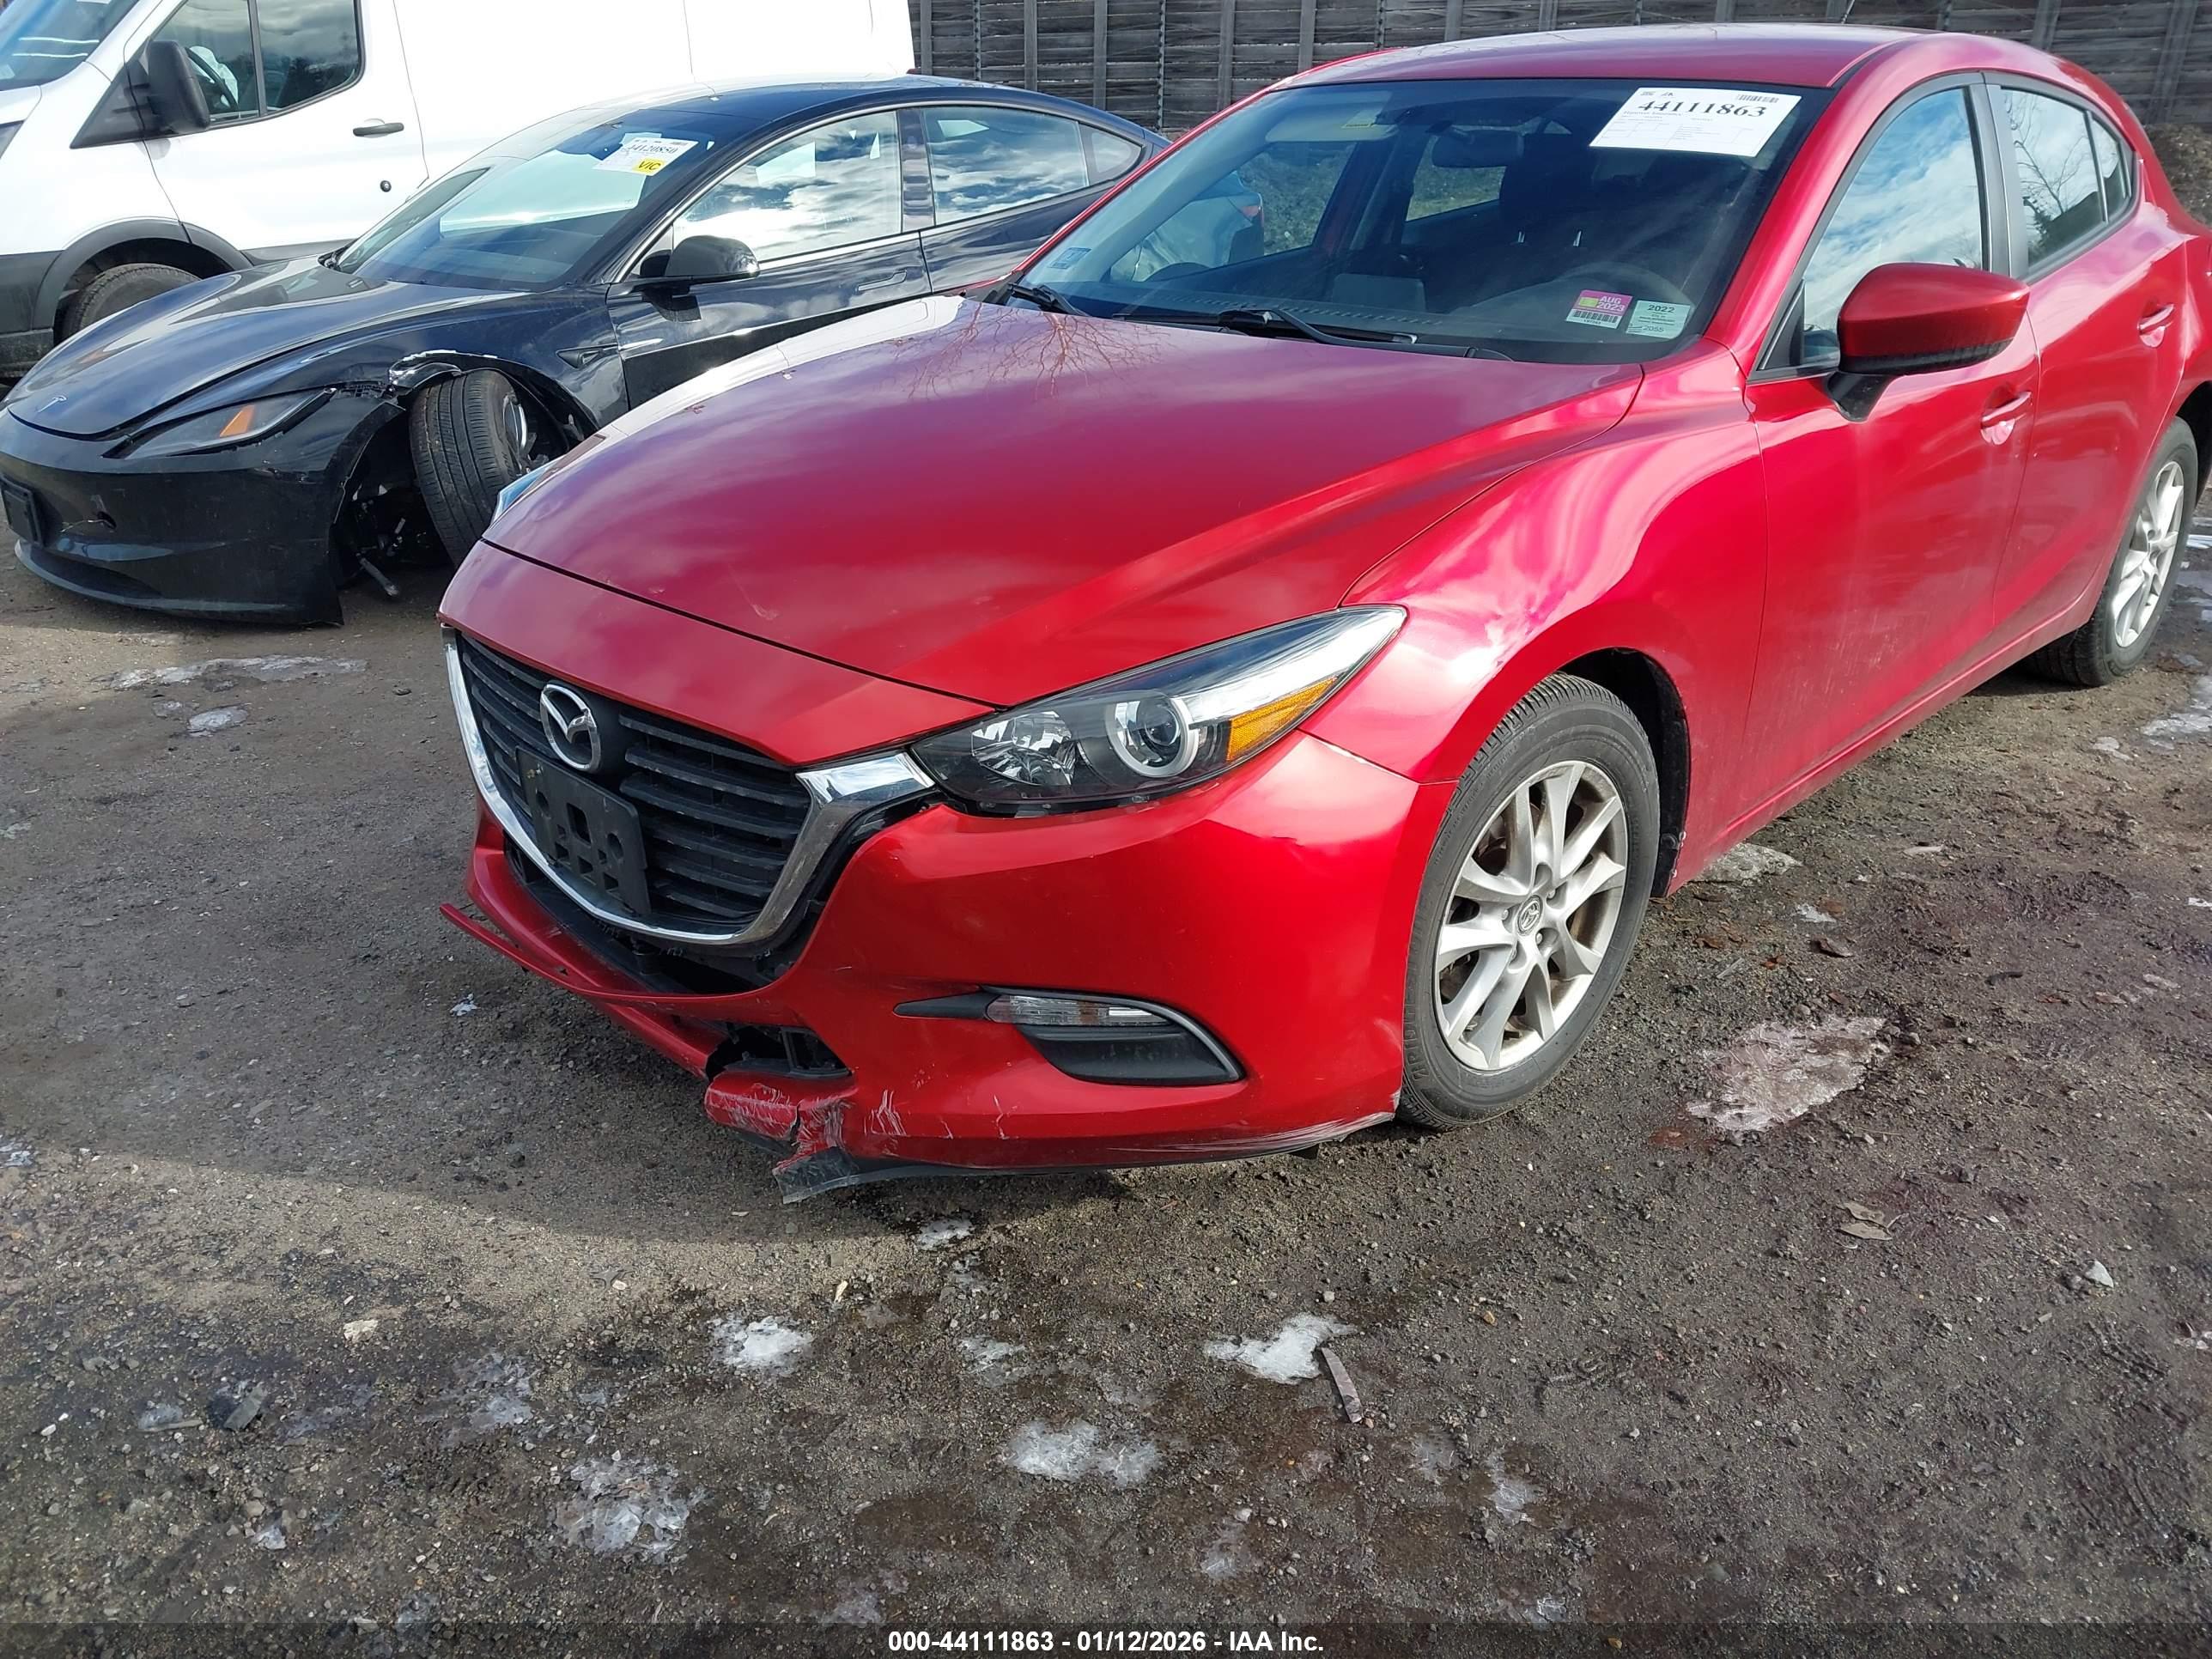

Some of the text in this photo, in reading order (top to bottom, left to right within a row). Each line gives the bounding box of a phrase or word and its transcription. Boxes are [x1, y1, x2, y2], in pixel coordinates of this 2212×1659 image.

[1638, 100, 1766, 118] 44111863
[639, 161, 661, 170] VIC
[1599, 295, 1622, 305] AUG
[1595, 301, 1626, 312] 2023
[1647, 304, 1675, 313] 2022
